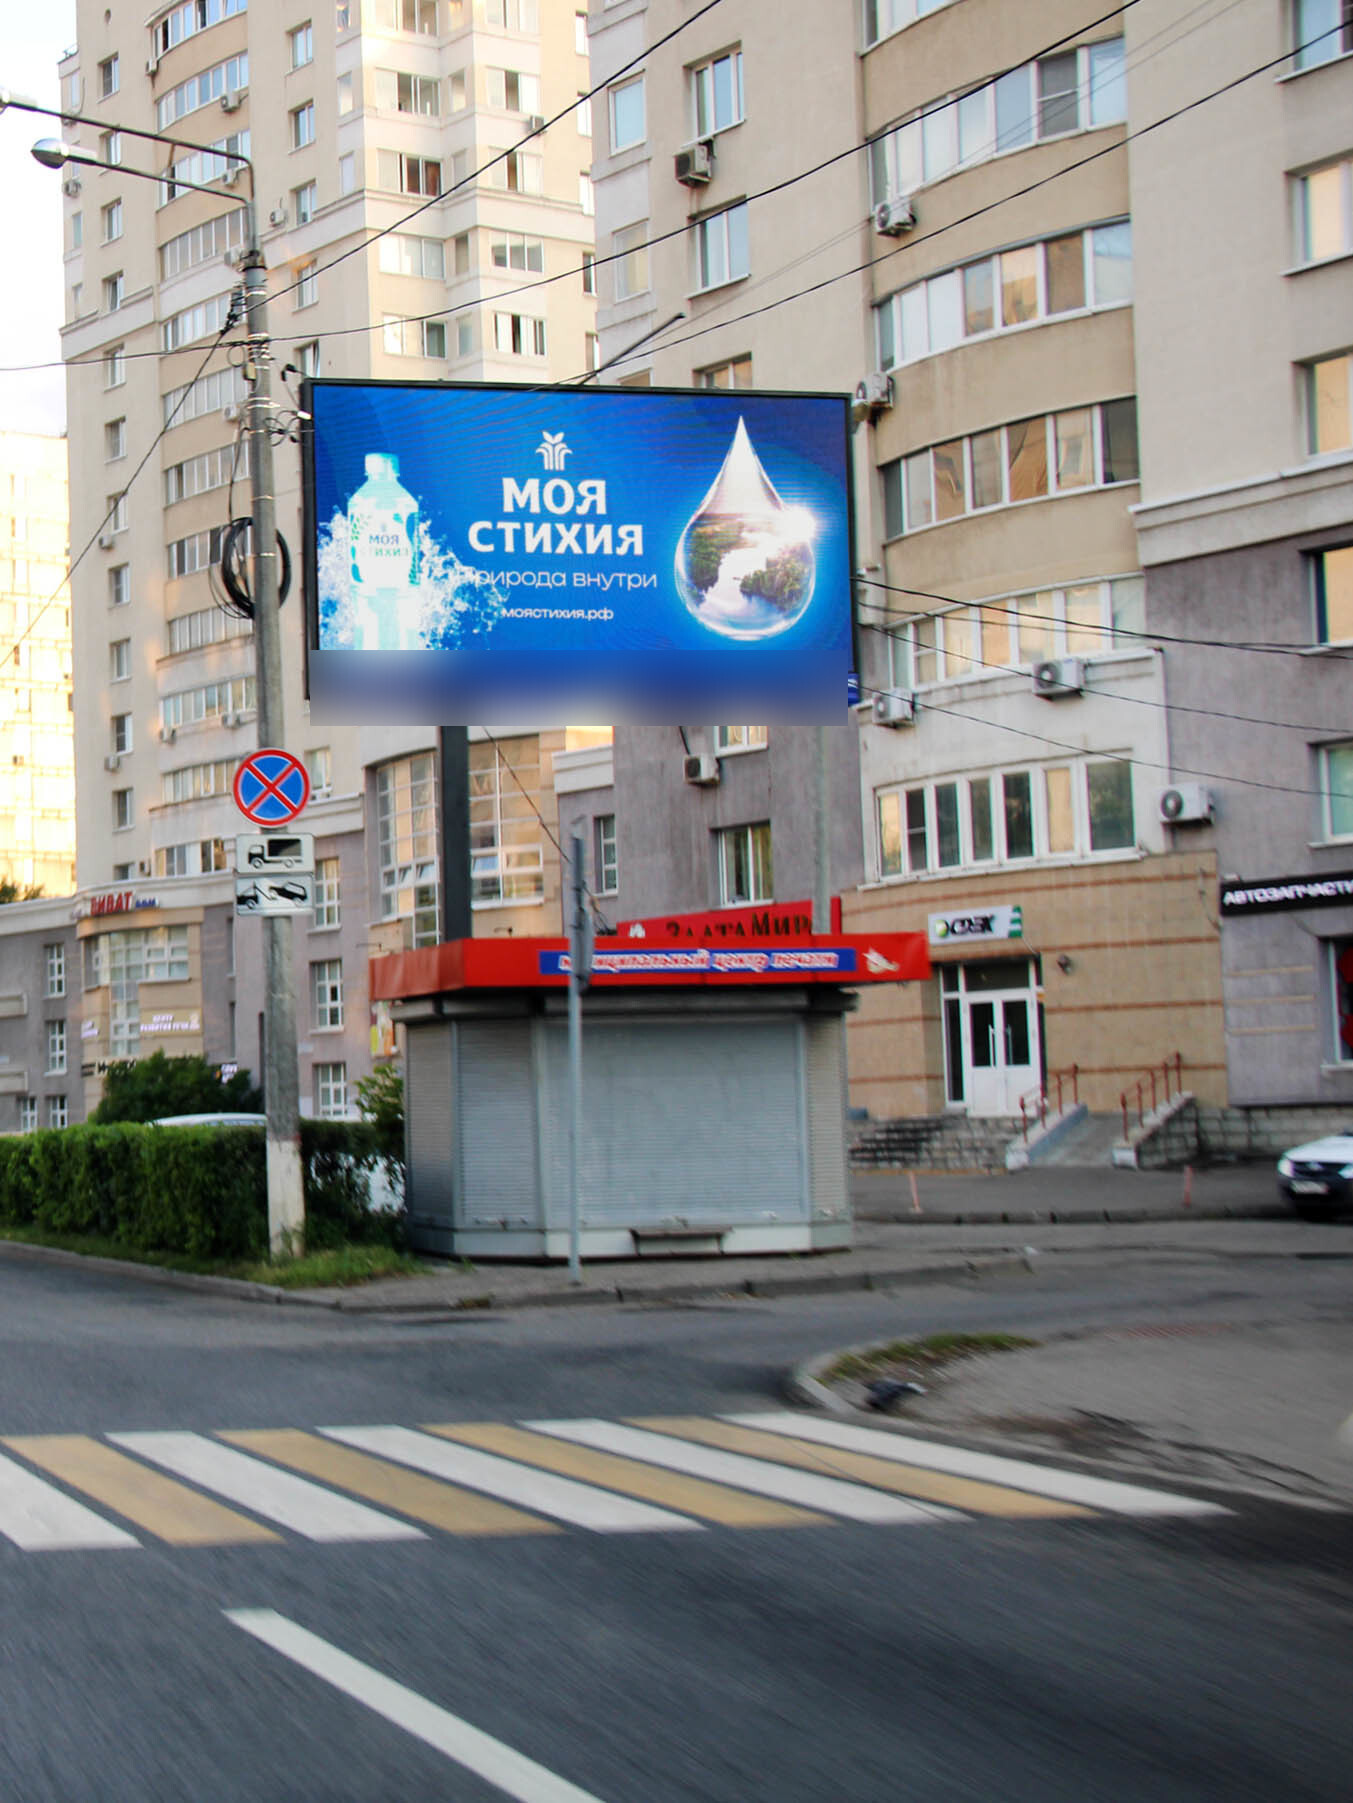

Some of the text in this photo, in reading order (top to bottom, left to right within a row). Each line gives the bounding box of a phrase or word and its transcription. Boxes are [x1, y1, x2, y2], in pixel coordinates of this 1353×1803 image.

[502, 477, 607, 515] МОЯ
[468, 520, 644, 556] СТИХИЯ
[572, 571, 658, 592] внутри
[501, 607, 614, 621] моястихия.рф
